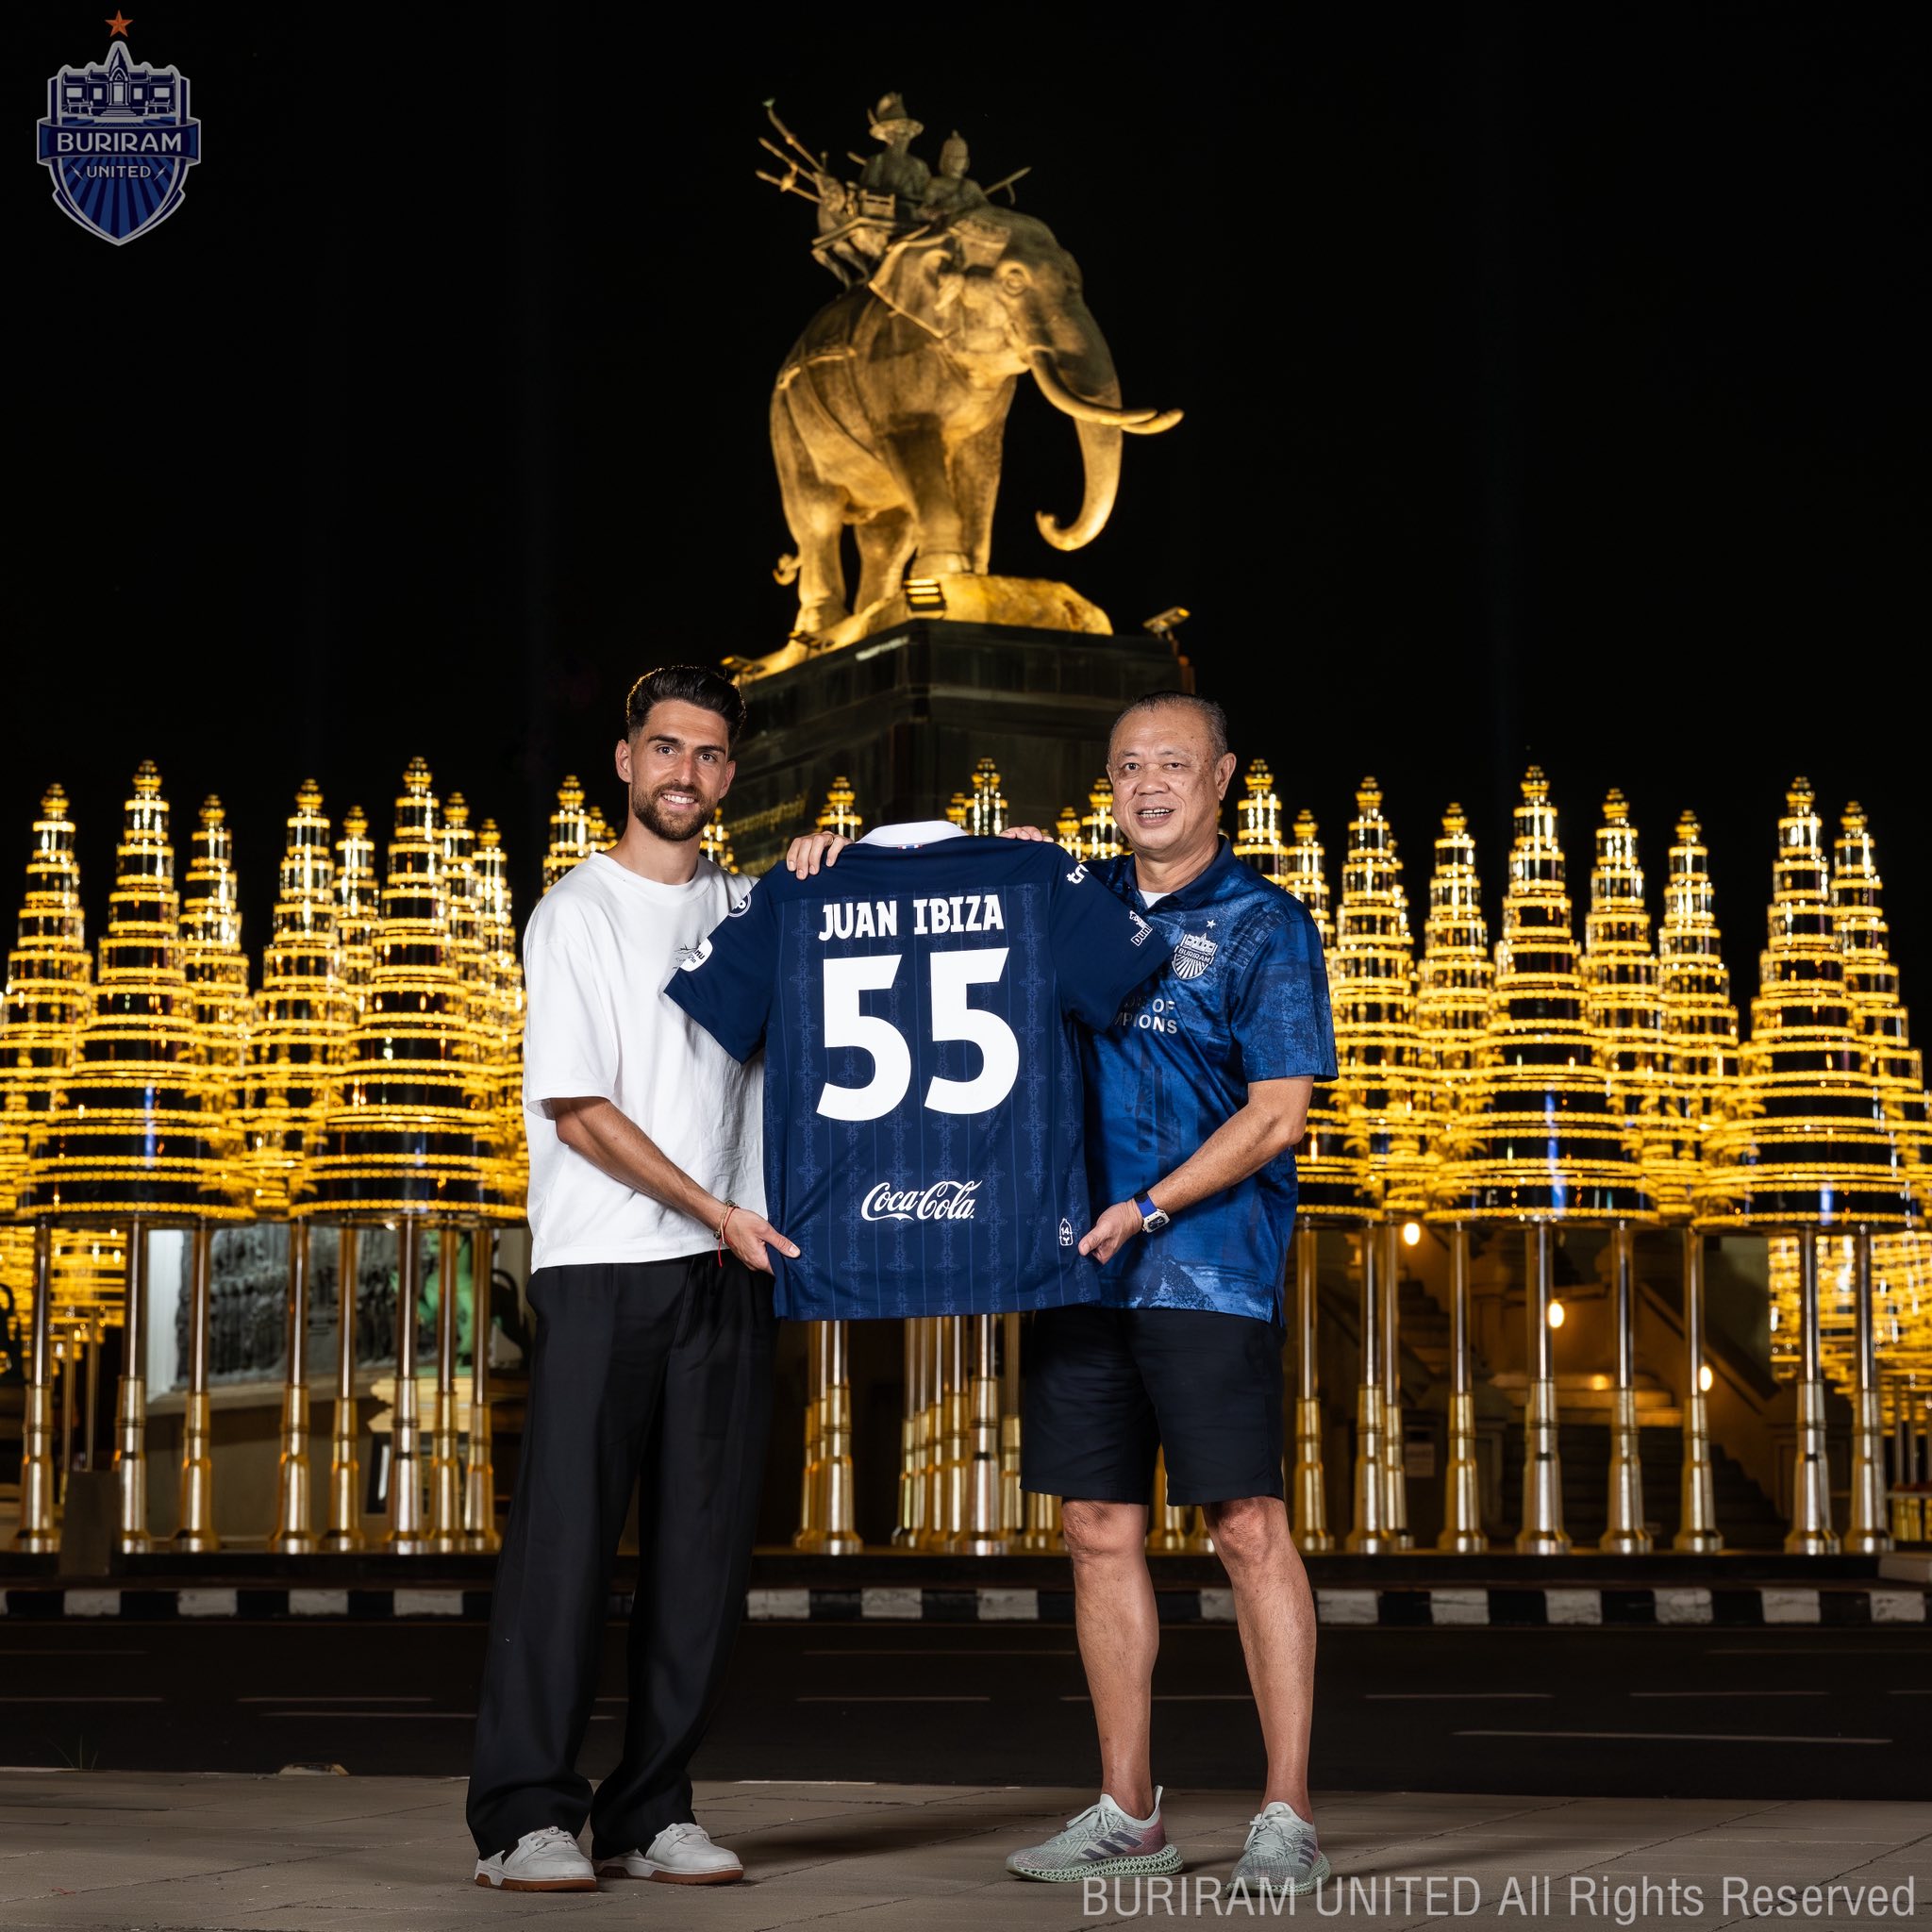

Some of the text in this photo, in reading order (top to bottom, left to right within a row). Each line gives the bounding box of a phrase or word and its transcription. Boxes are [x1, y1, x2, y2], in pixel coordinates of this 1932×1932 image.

[818, 894, 1005, 941] JUAN IBIZA
[1177, 946, 1211, 963] BURIRAM
[1152, 998, 1175, 1014] OF
[815, 947, 1020, 1122] 55
[1061, 1226, 1070, 1236] 14
